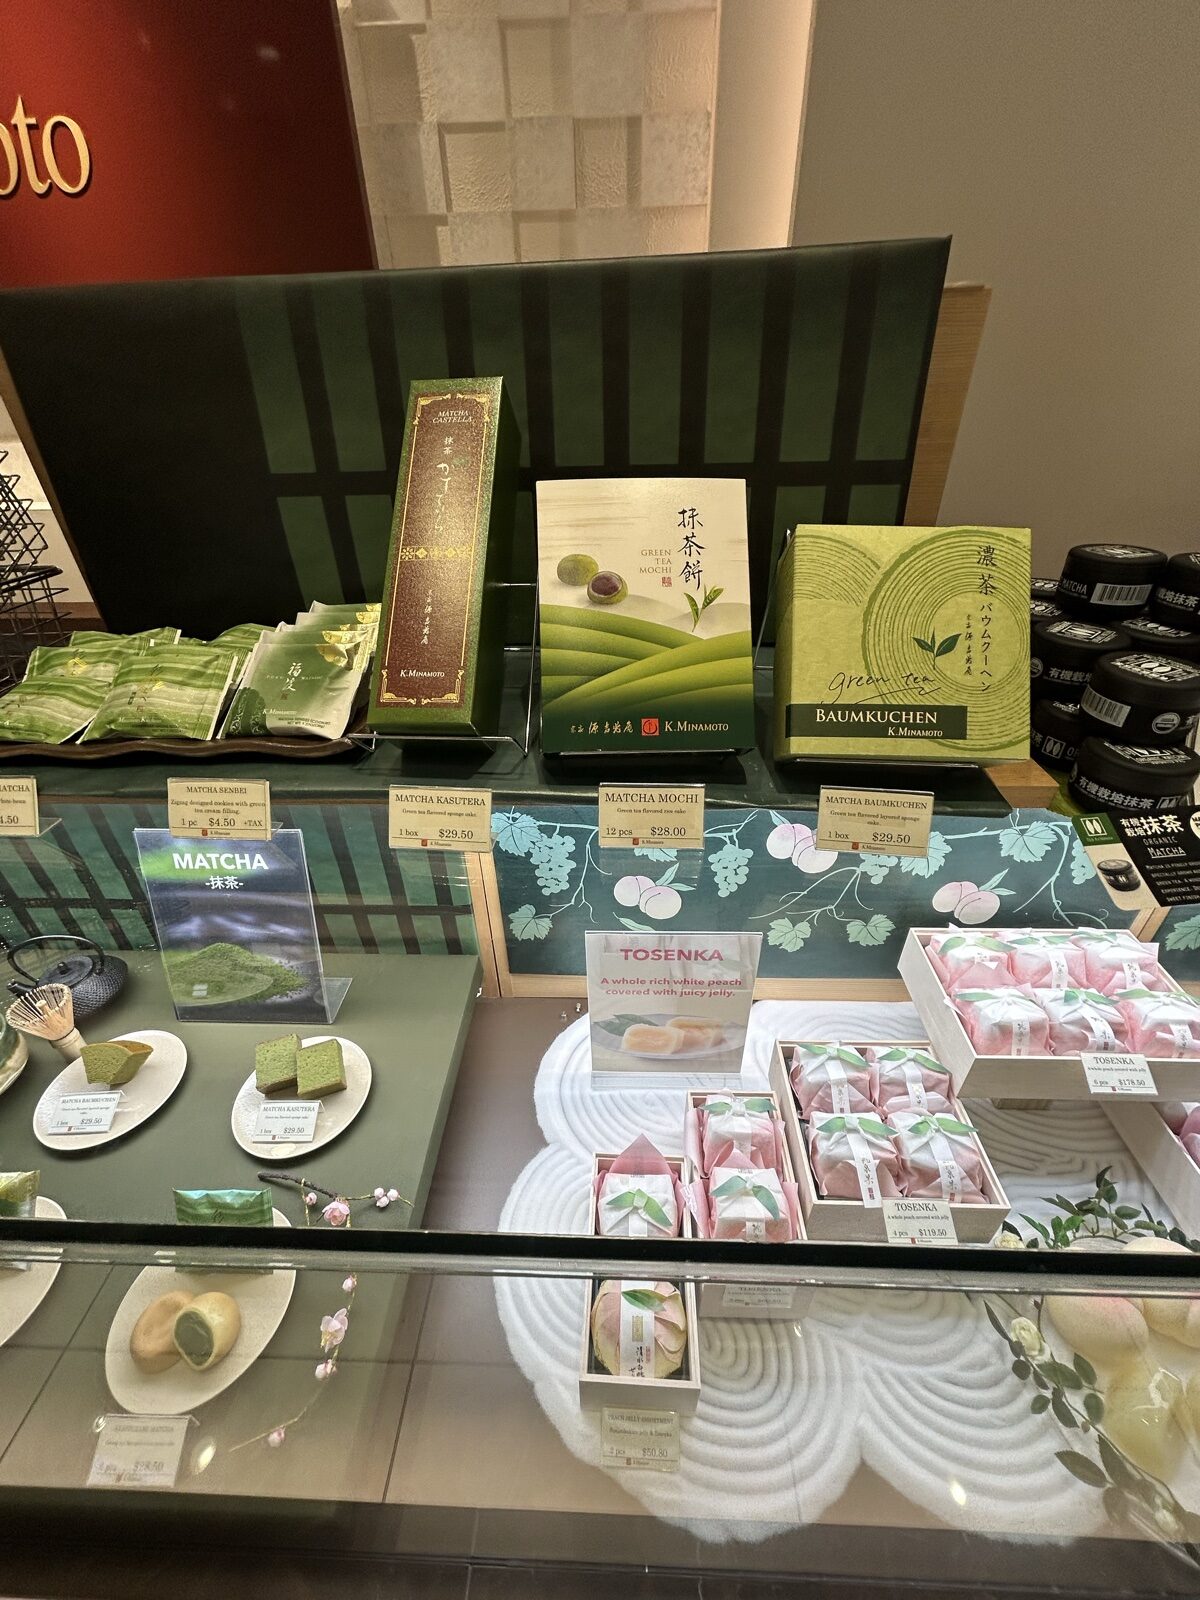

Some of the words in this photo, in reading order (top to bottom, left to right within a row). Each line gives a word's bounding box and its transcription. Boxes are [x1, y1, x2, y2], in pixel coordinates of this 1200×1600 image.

[432, 416, 473, 424] CASTELLA
[640, 549, 672, 557] GREEN
[655, 558, 672, 566] TEA
[639, 566, 672, 574] MOCHI
[901, 673, 935, 686] tea
[186, 786, 218, 794] MATCHA
[395, 794, 434, 804] MATCHA
[436, 796, 486, 806] KASUTERA
[605, 793, 655, 803] MATCHA
[658, 794, 699, 803] MOCHI
[826, 796, 862, 805] MATCHA
[864, 799, 928, 810] BAUMKUCHEN
[857, 811, 879, 819] flavored
[181, 818, 185, 826] 1
[188, 820, 197, 828] pc
[208, 817, 236, 827] $4.50
[1140, 814, 1184, 836] 抹茶
[405, 829, 419, 837] box
[438, 828, 474, 839] $29.50
[606, 827, 616, 836] 12
[650, 826, 686, 837] $28.00
[835, 831, 849, 840] box
[872, 832, 911, 844] $29.50
[1142, 836, 1178, 846] ORGANIC
[1147, 846, 1186, 858] MATCHA
[172, 853, 269, 870] MATCHA
[620, 948, 724, 962] TOSENKA
[601, 977, 609, 985] A
[612, 977, 646, 985] whole
[649, 977, 670, 985] rich
[673, 978, 705, 986] white
[708, 978, 742, 987] peach
[606, 988, 650, 996] covered
[653, 988, 677, 996] with
[679, 988, 706, 998] juicy
[708, 988, 735, 998] jelly.
[1093, 1056, 1135, 1065] TOSENKA
[80, 1117, 103, 1125] $29.50
[894, 1202, 938, 1212] TOSENKA
[919, 1228, 947, 1237] $119.50
